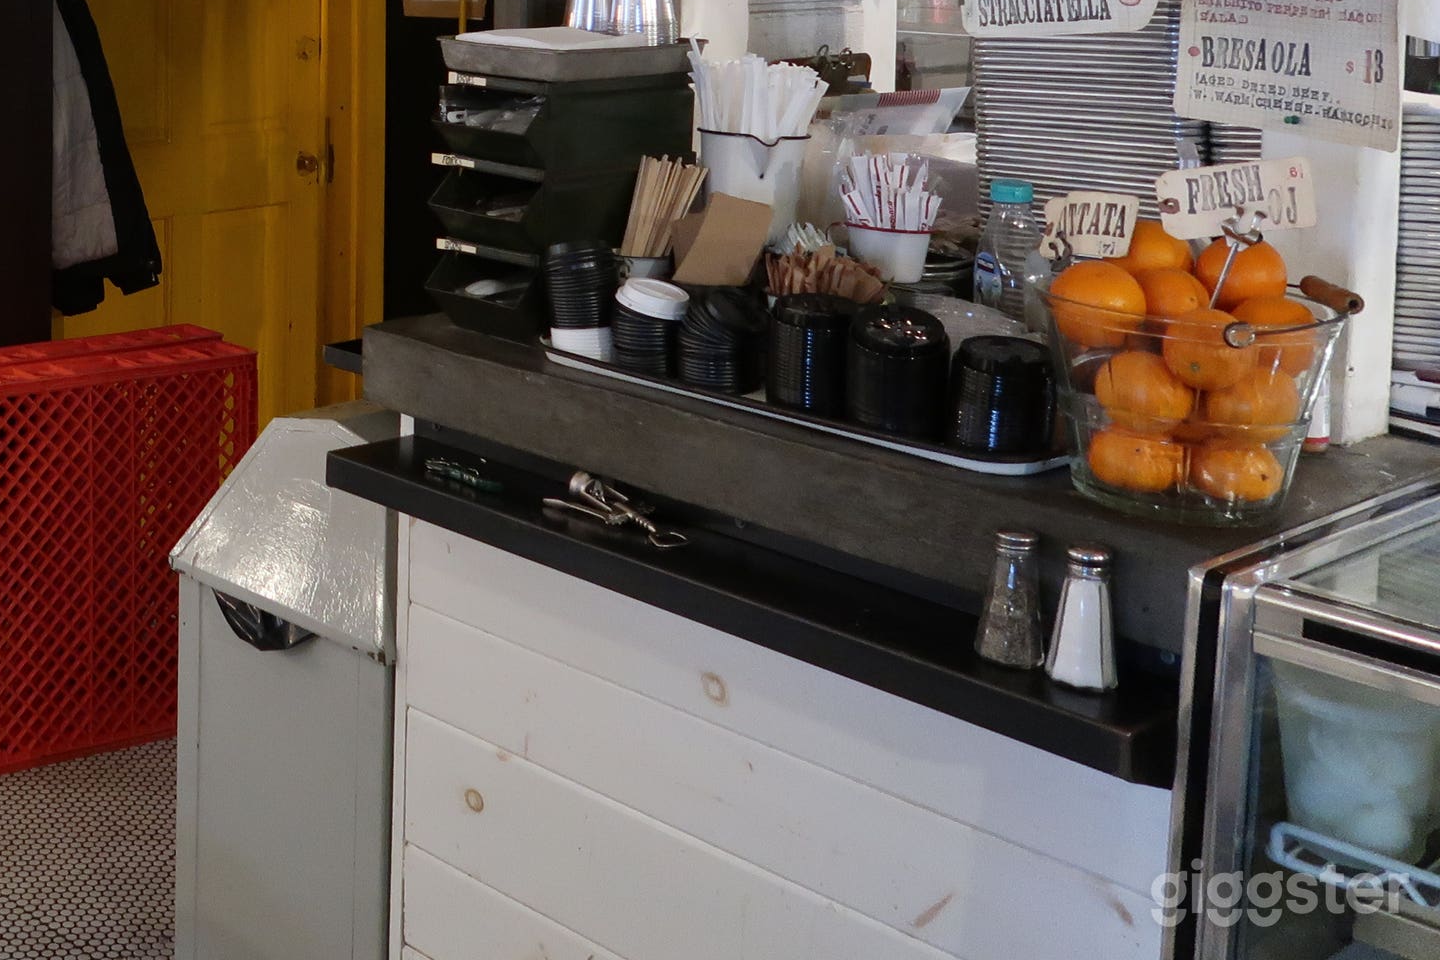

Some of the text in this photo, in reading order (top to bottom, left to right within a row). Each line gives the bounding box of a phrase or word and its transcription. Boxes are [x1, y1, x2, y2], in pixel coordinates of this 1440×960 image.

[1201, 35, 1311, 77] BRESAOLA
[1363, 49, 1384, 85] 13
[1185, 164, 1264, 215] FRESH
[1267, 186, 1297, 225] OJ
